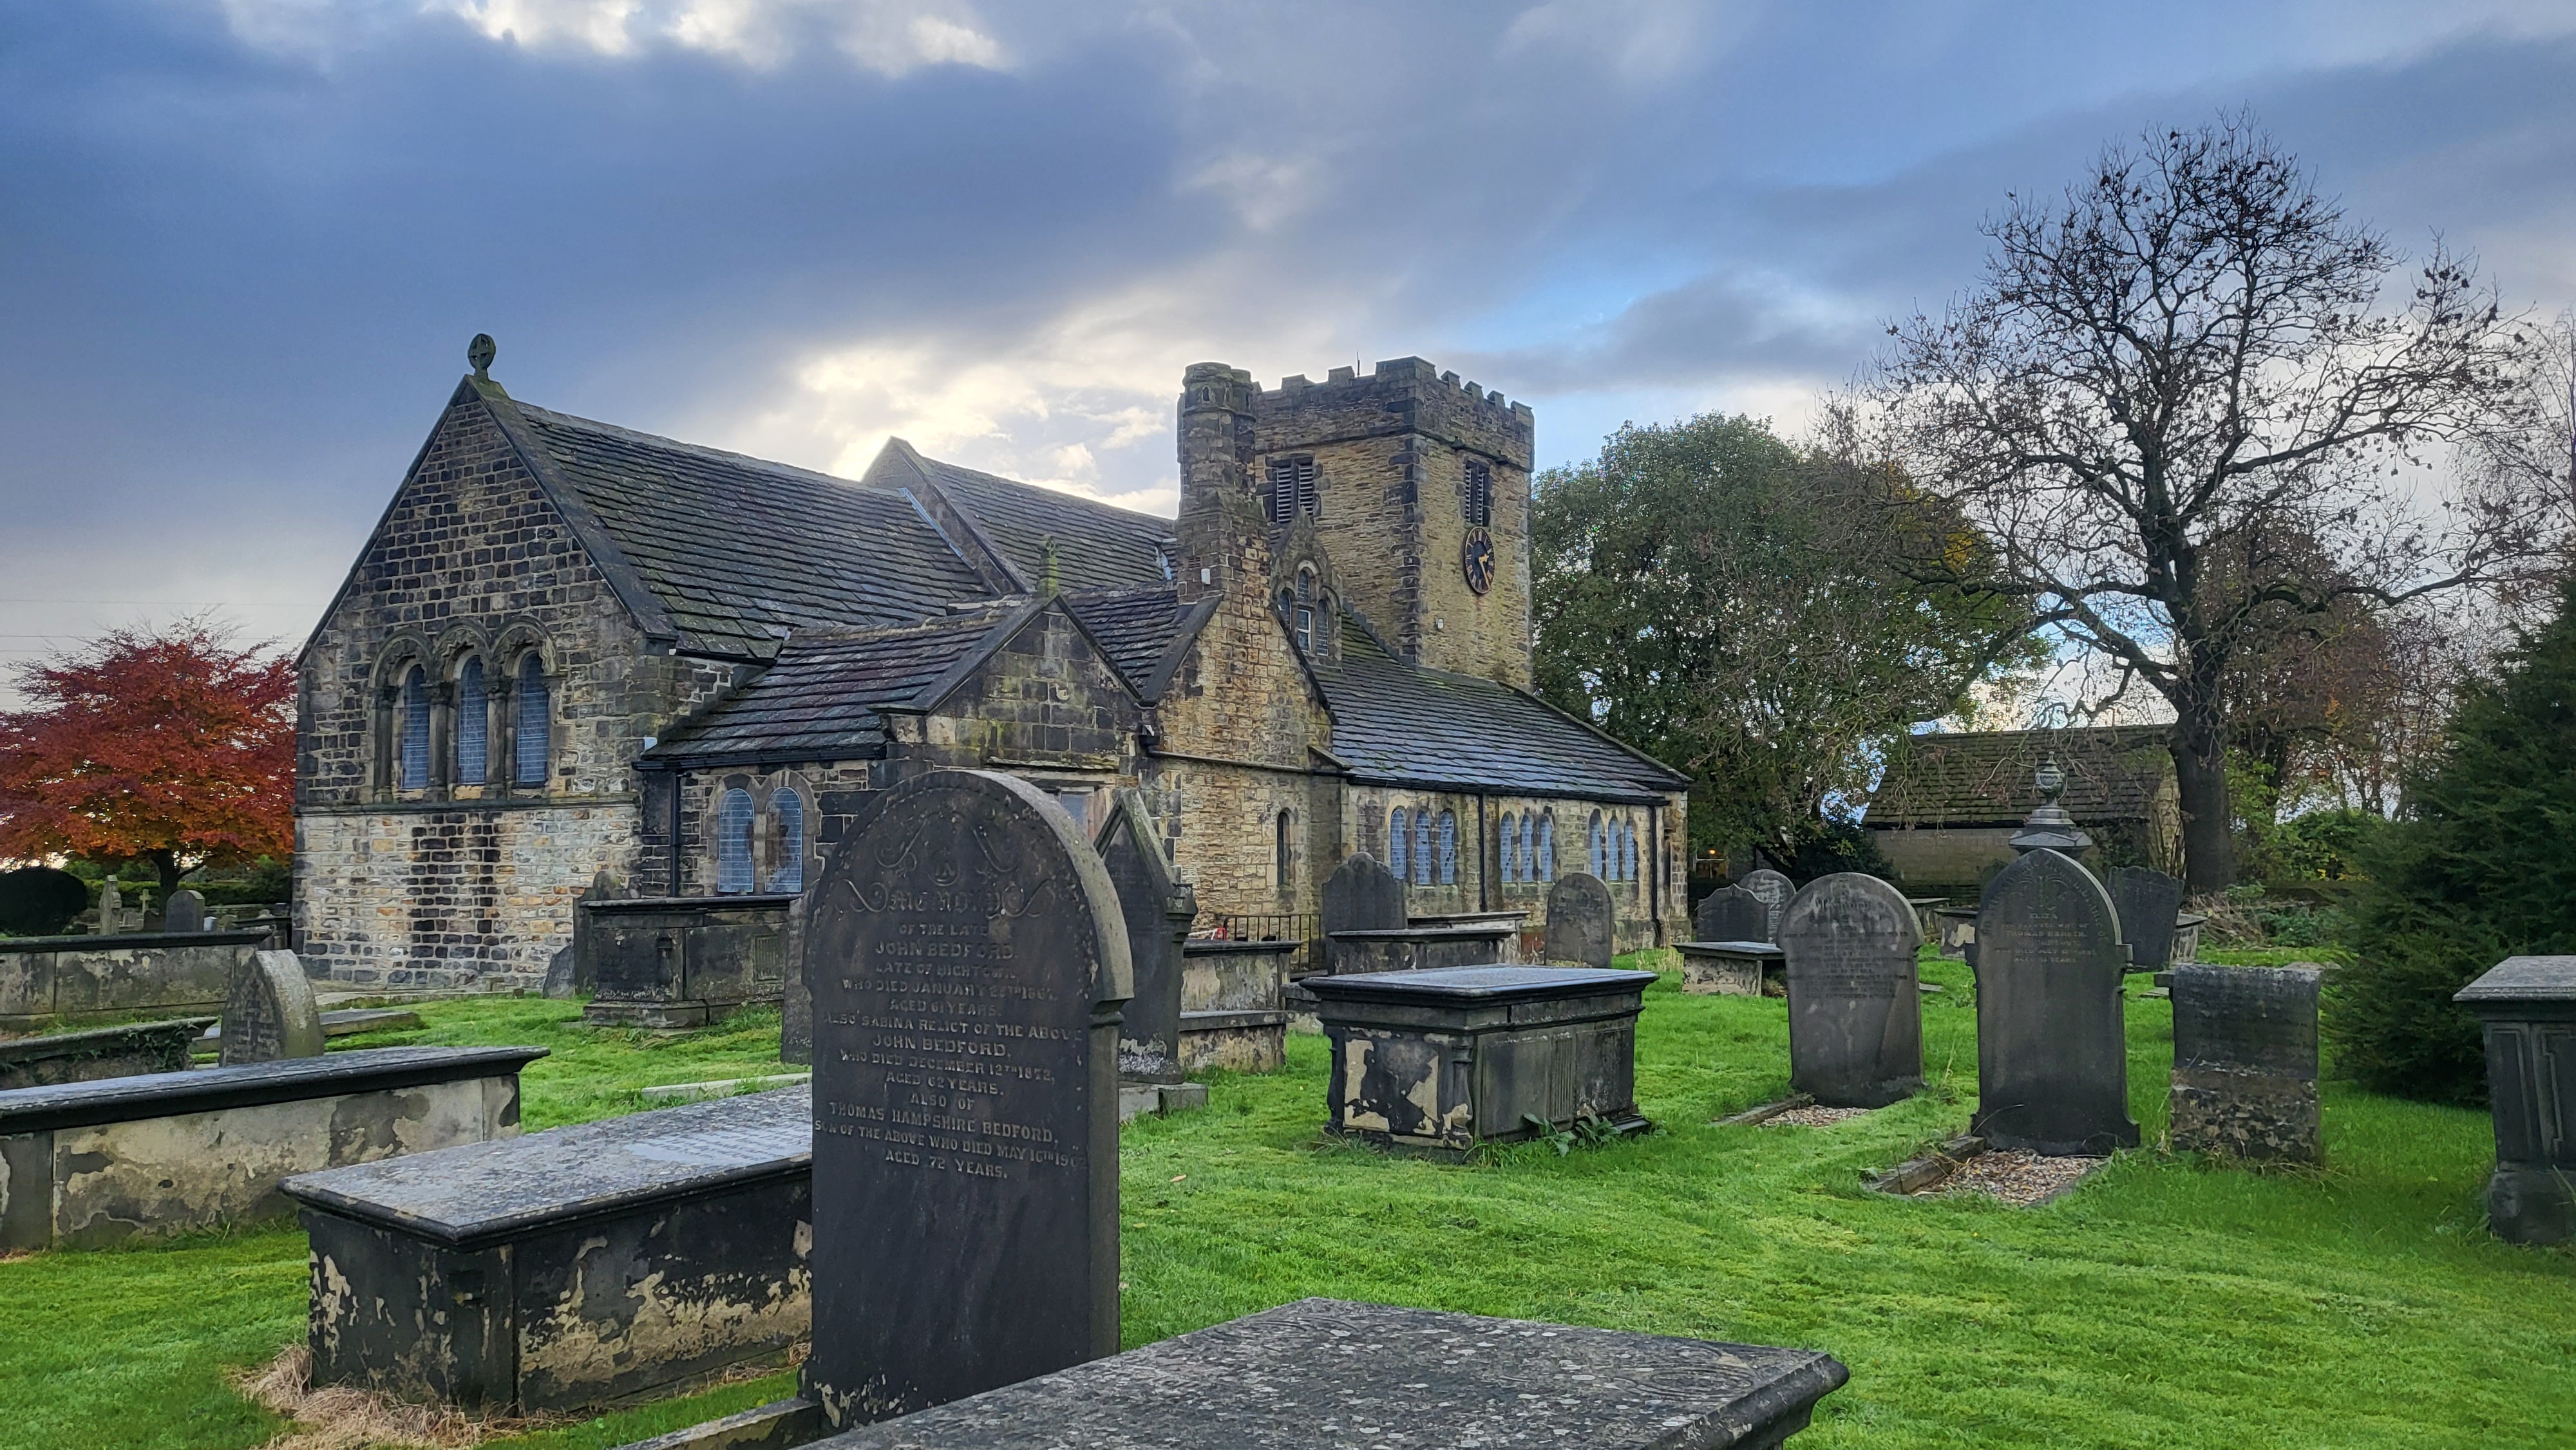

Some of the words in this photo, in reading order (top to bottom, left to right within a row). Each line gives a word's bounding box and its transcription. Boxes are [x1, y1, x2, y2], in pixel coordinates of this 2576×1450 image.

[934, 863, 956, 877] IN
[899, 925, 914, 936] OF
[920, 924, 945, 936] THE
[951, 924, 987, 937] LATE
[875, 938, 922, 957] JOHN
[875, 962, 912, 975] LATE
[916, 963, 932, 975] OF
[842, 978, 872, 990] WHO
[876, 980, 907, 993] DIED
[912, 981, 983, 997] JANUARY
[889, 999, 927, 1013] AGED
[824, 1012, 855, 1025] ALSO
[861, 1015, 914, 1030] SABINA
[919, 1019, 969, 1034] RELICT
[974, 1022, 990, 1035] OF
[996, 1023, 1024, 1038] THE
[1028, 1025, 1082, 1041] ABOVE
[873, 1033, 916, 1050] JOHN
[840, 1048, 867, 1062] WHO
[872, 1052, 903, 1066] DIED
[909, 1056, 985, 1075] DECEMBER
[886, 1071, 921, 1086] AGED
[927, 1076, 945, 1089] 62
[947, 1077, 1004, 1097] YEARS.
[910, 1092, 947, 1108] ALSO
[958, 1097, 975, 1111] OF
[829, 1101, 885, 1122] THOMAS
[891, 1107, 976, 1133] HAMPSHIRE
[815, 1120, 837, 1133] SON
[840, 1124, 854, 1136] OF
[858, 1125, 880, 1140] THE
[884, 1129, 925, 1147] ABOVE
[928, 1134, 958, 1151] WHO
[962, 1138, 992, 1156] DIED
[997, 1143, 1026, 1161] MAY
[885, 1148, 920, 1166] AGED
[927, 1154, 945, 1170] 72
[954, 1158, 1008, 1179] YEARS.
